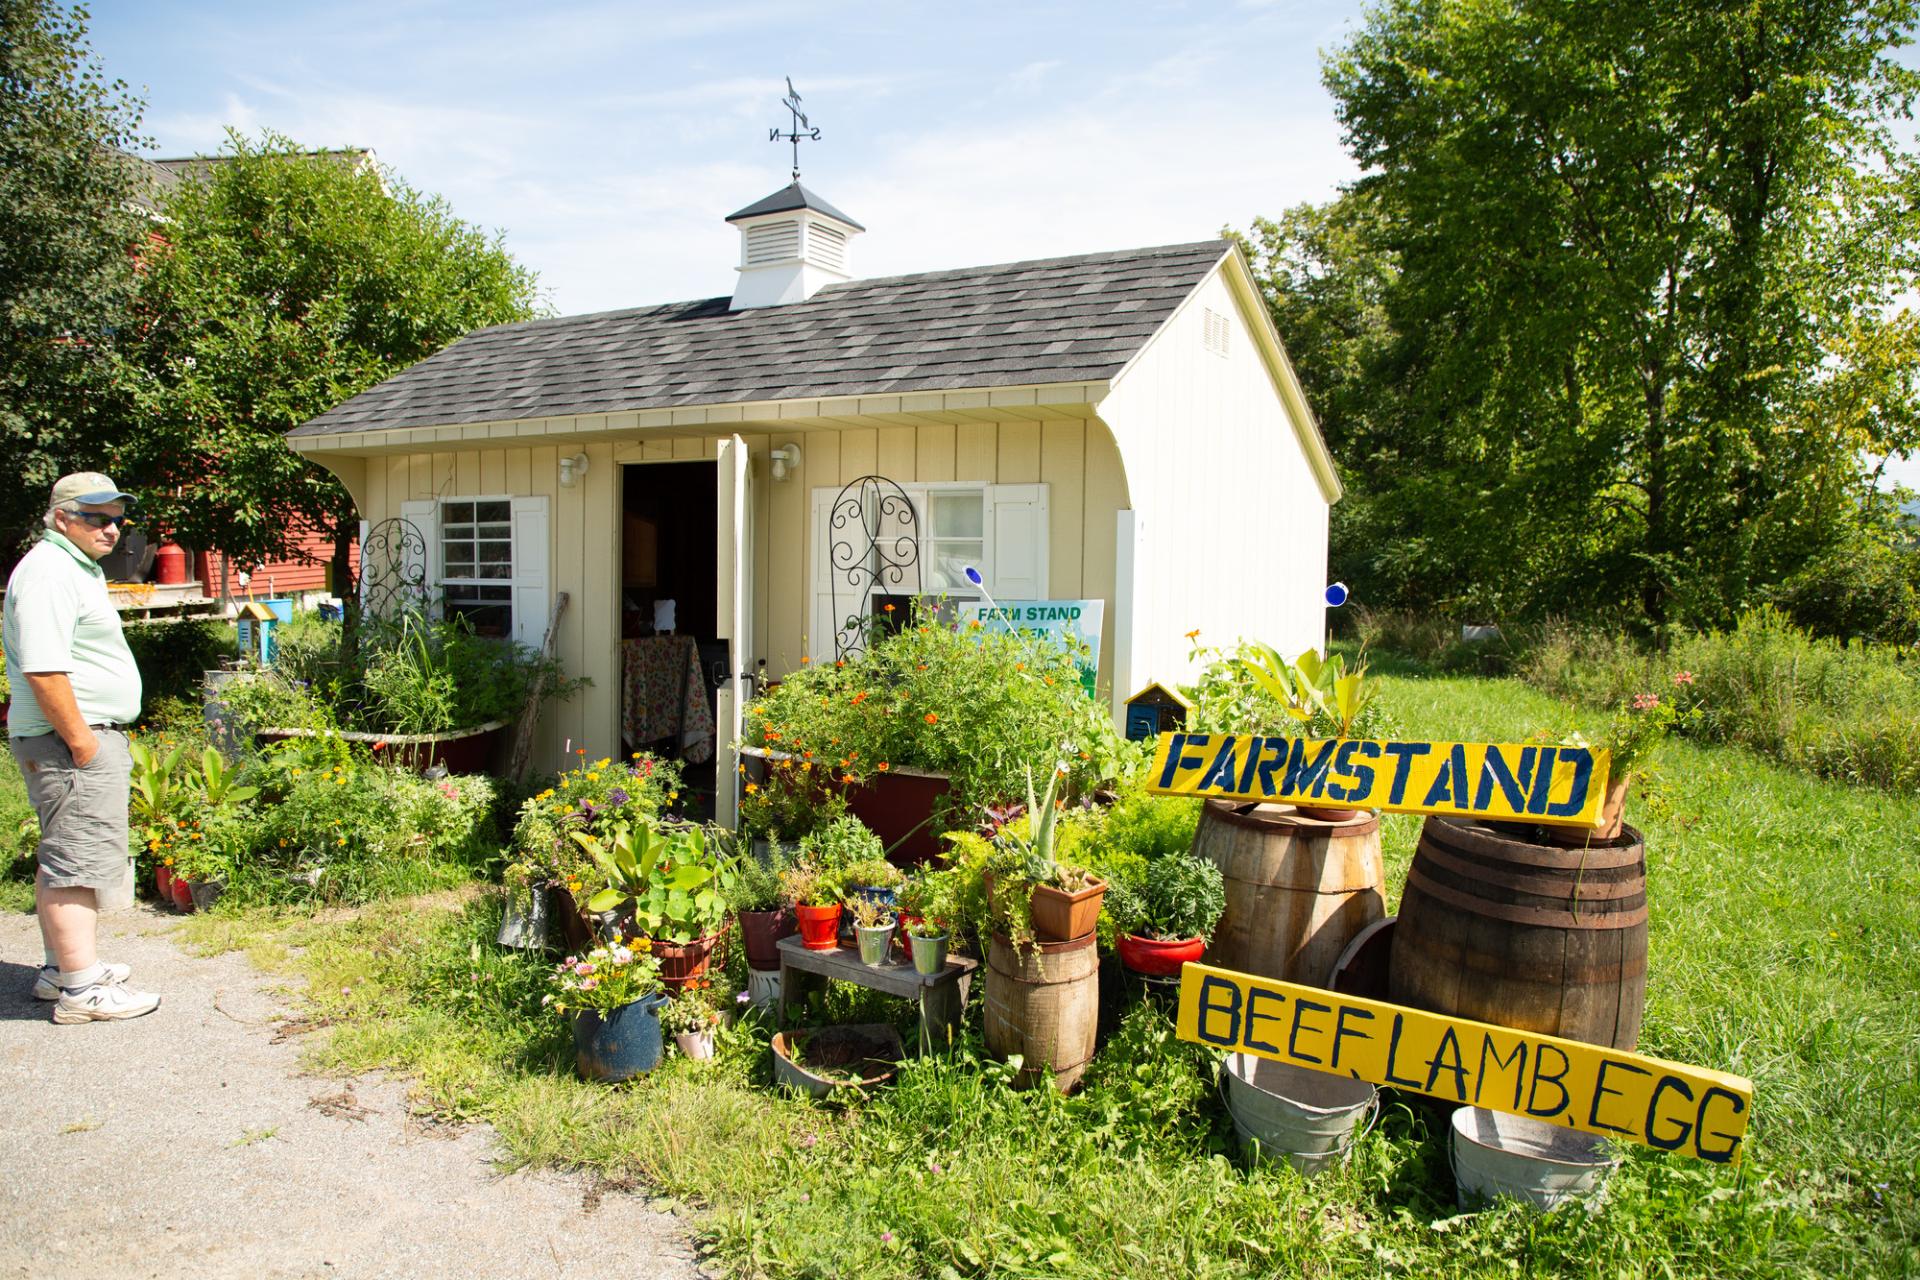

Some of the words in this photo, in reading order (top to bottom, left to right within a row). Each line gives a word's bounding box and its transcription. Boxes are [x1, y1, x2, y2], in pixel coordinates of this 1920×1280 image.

[977, 607, 1021, 621] FARM
[1026, 606, 1081, 620] STAND
[1004, 627, 1049, 641] OEN
[1158, 733, 1594, 817] FARMSTAND
[1588, 1059, 1745, 1164] EGG
